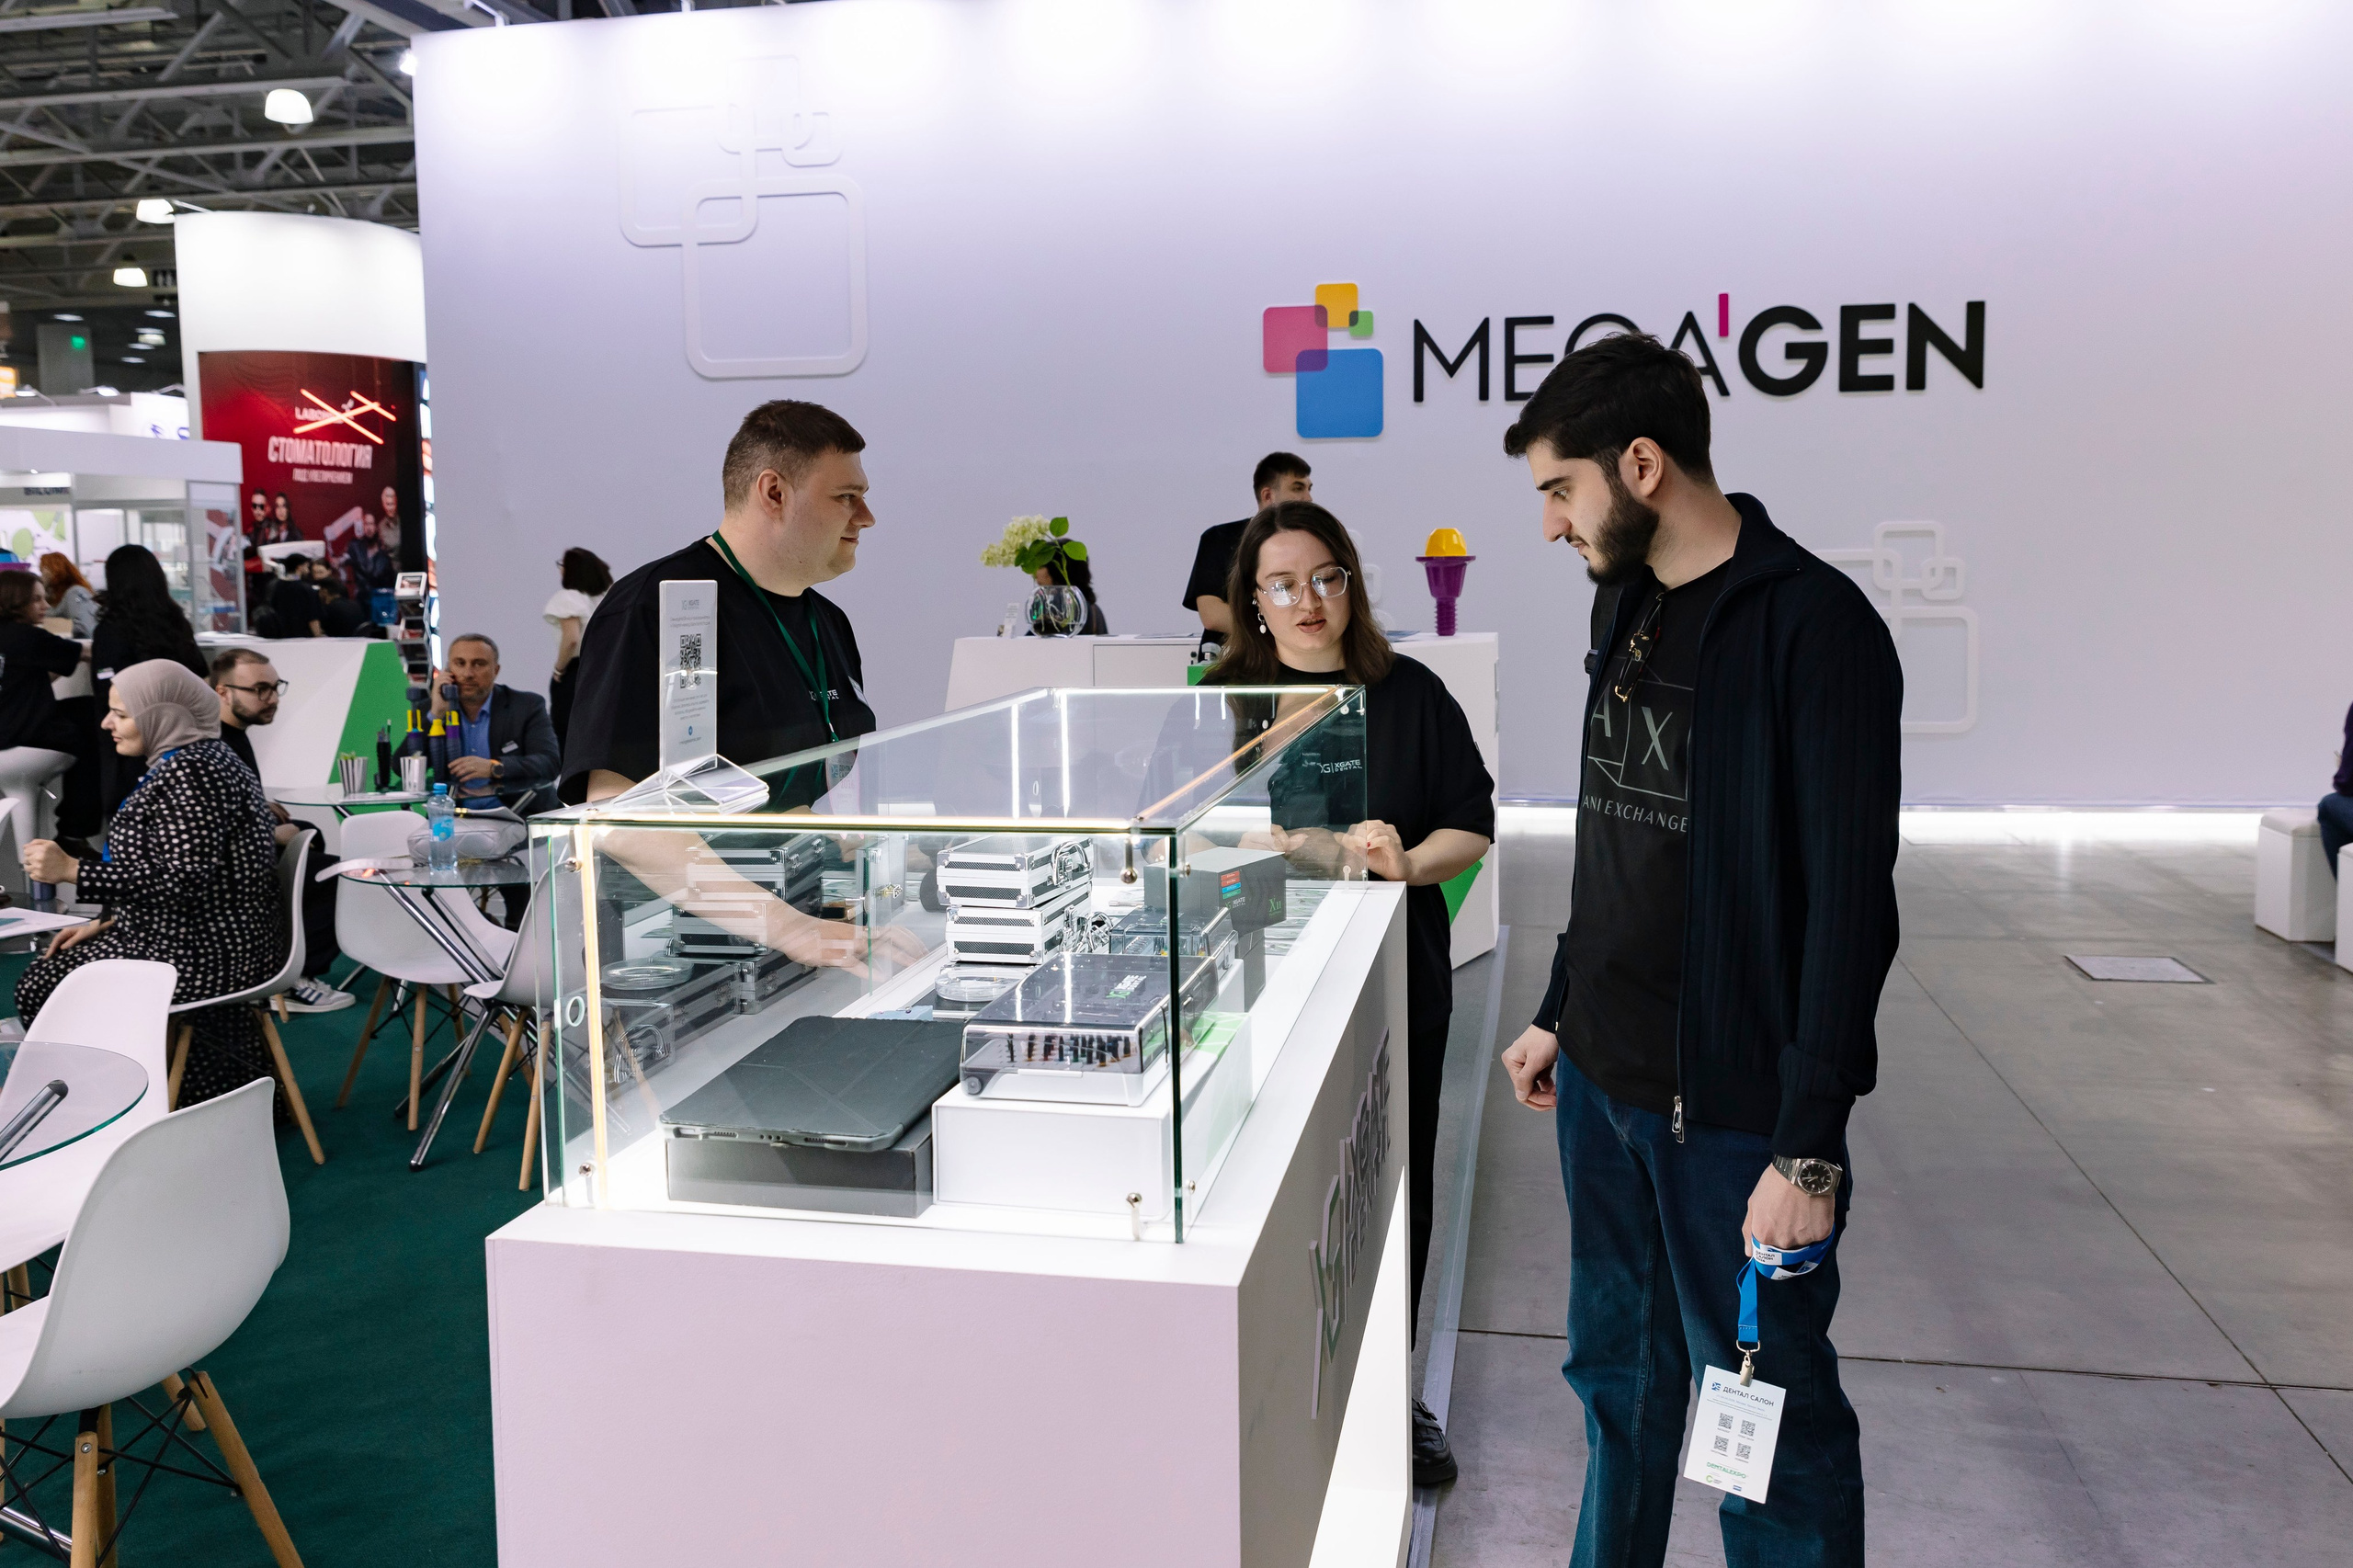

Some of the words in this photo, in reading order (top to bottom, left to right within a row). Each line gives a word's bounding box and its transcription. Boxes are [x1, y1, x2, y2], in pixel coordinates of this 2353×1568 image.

[267, 435, 373, 470] СТОМАТОЛОГИЯ
[1335, 759, 1361, 769] XGATE
[1604, 800, 1688, 833] EXCHANGE
[1722, 1386, 1749, 1399] ДЕНТАЛ
[1750, 1394, 1774, 1407] САЛОН
